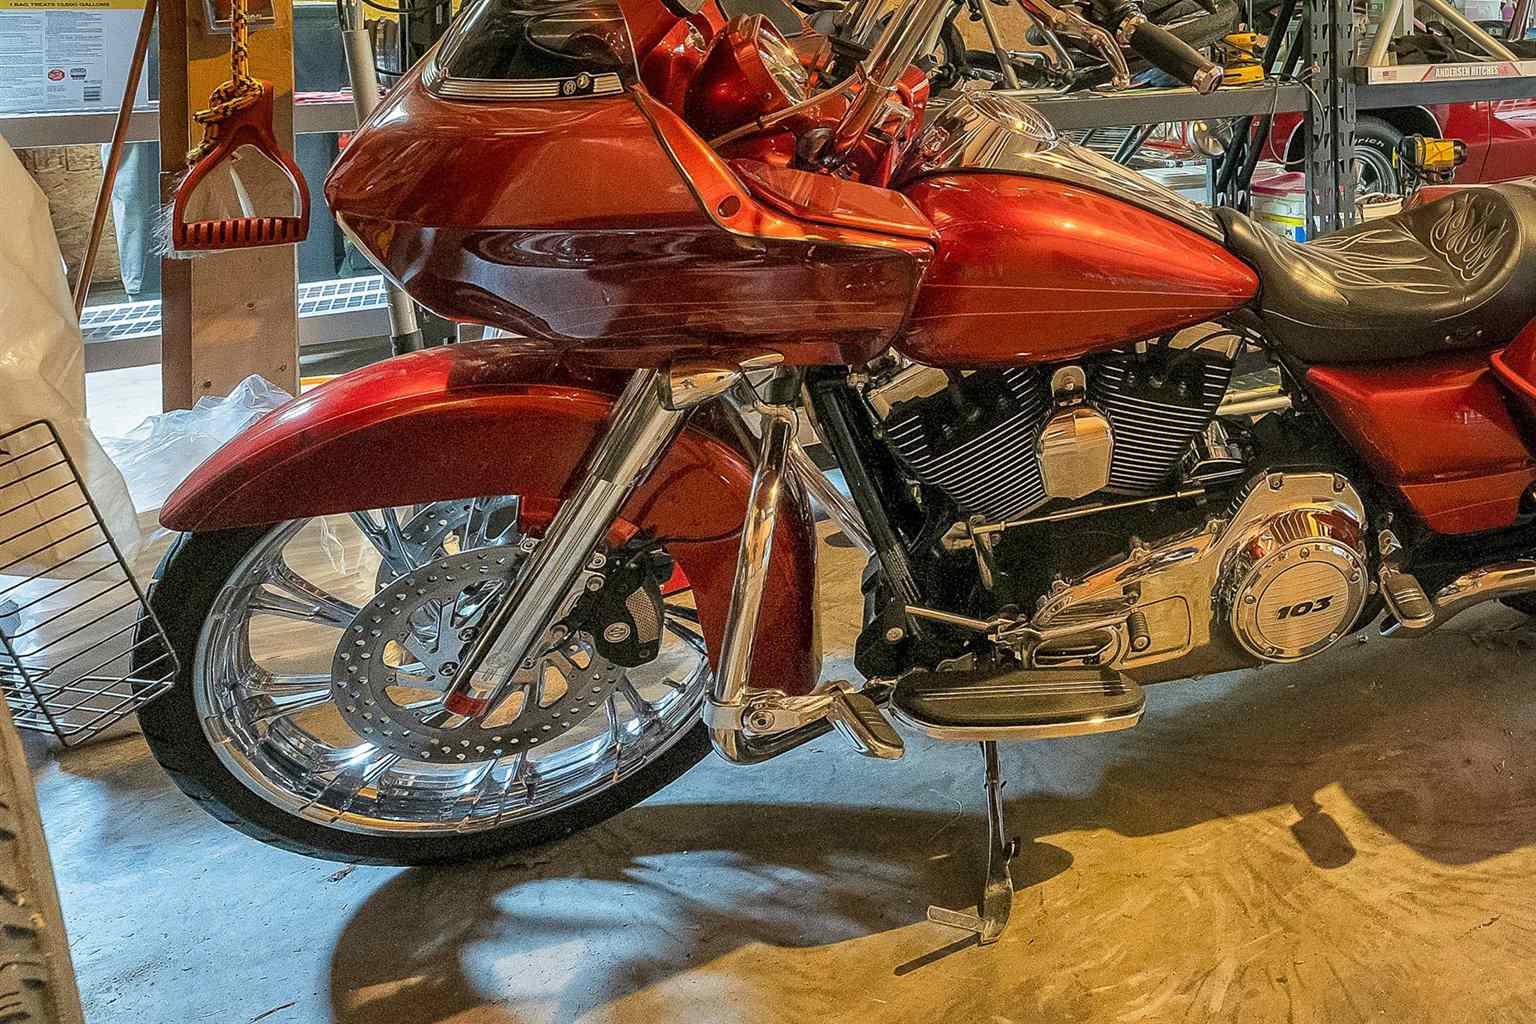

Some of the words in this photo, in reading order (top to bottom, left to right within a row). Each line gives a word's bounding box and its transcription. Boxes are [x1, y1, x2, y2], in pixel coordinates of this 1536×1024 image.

[1435, 66, 1471, 78] ANDERSEN
[1471, 65, 1498, 76] HITCHES
[1277, 595, 1335, 620] 103
